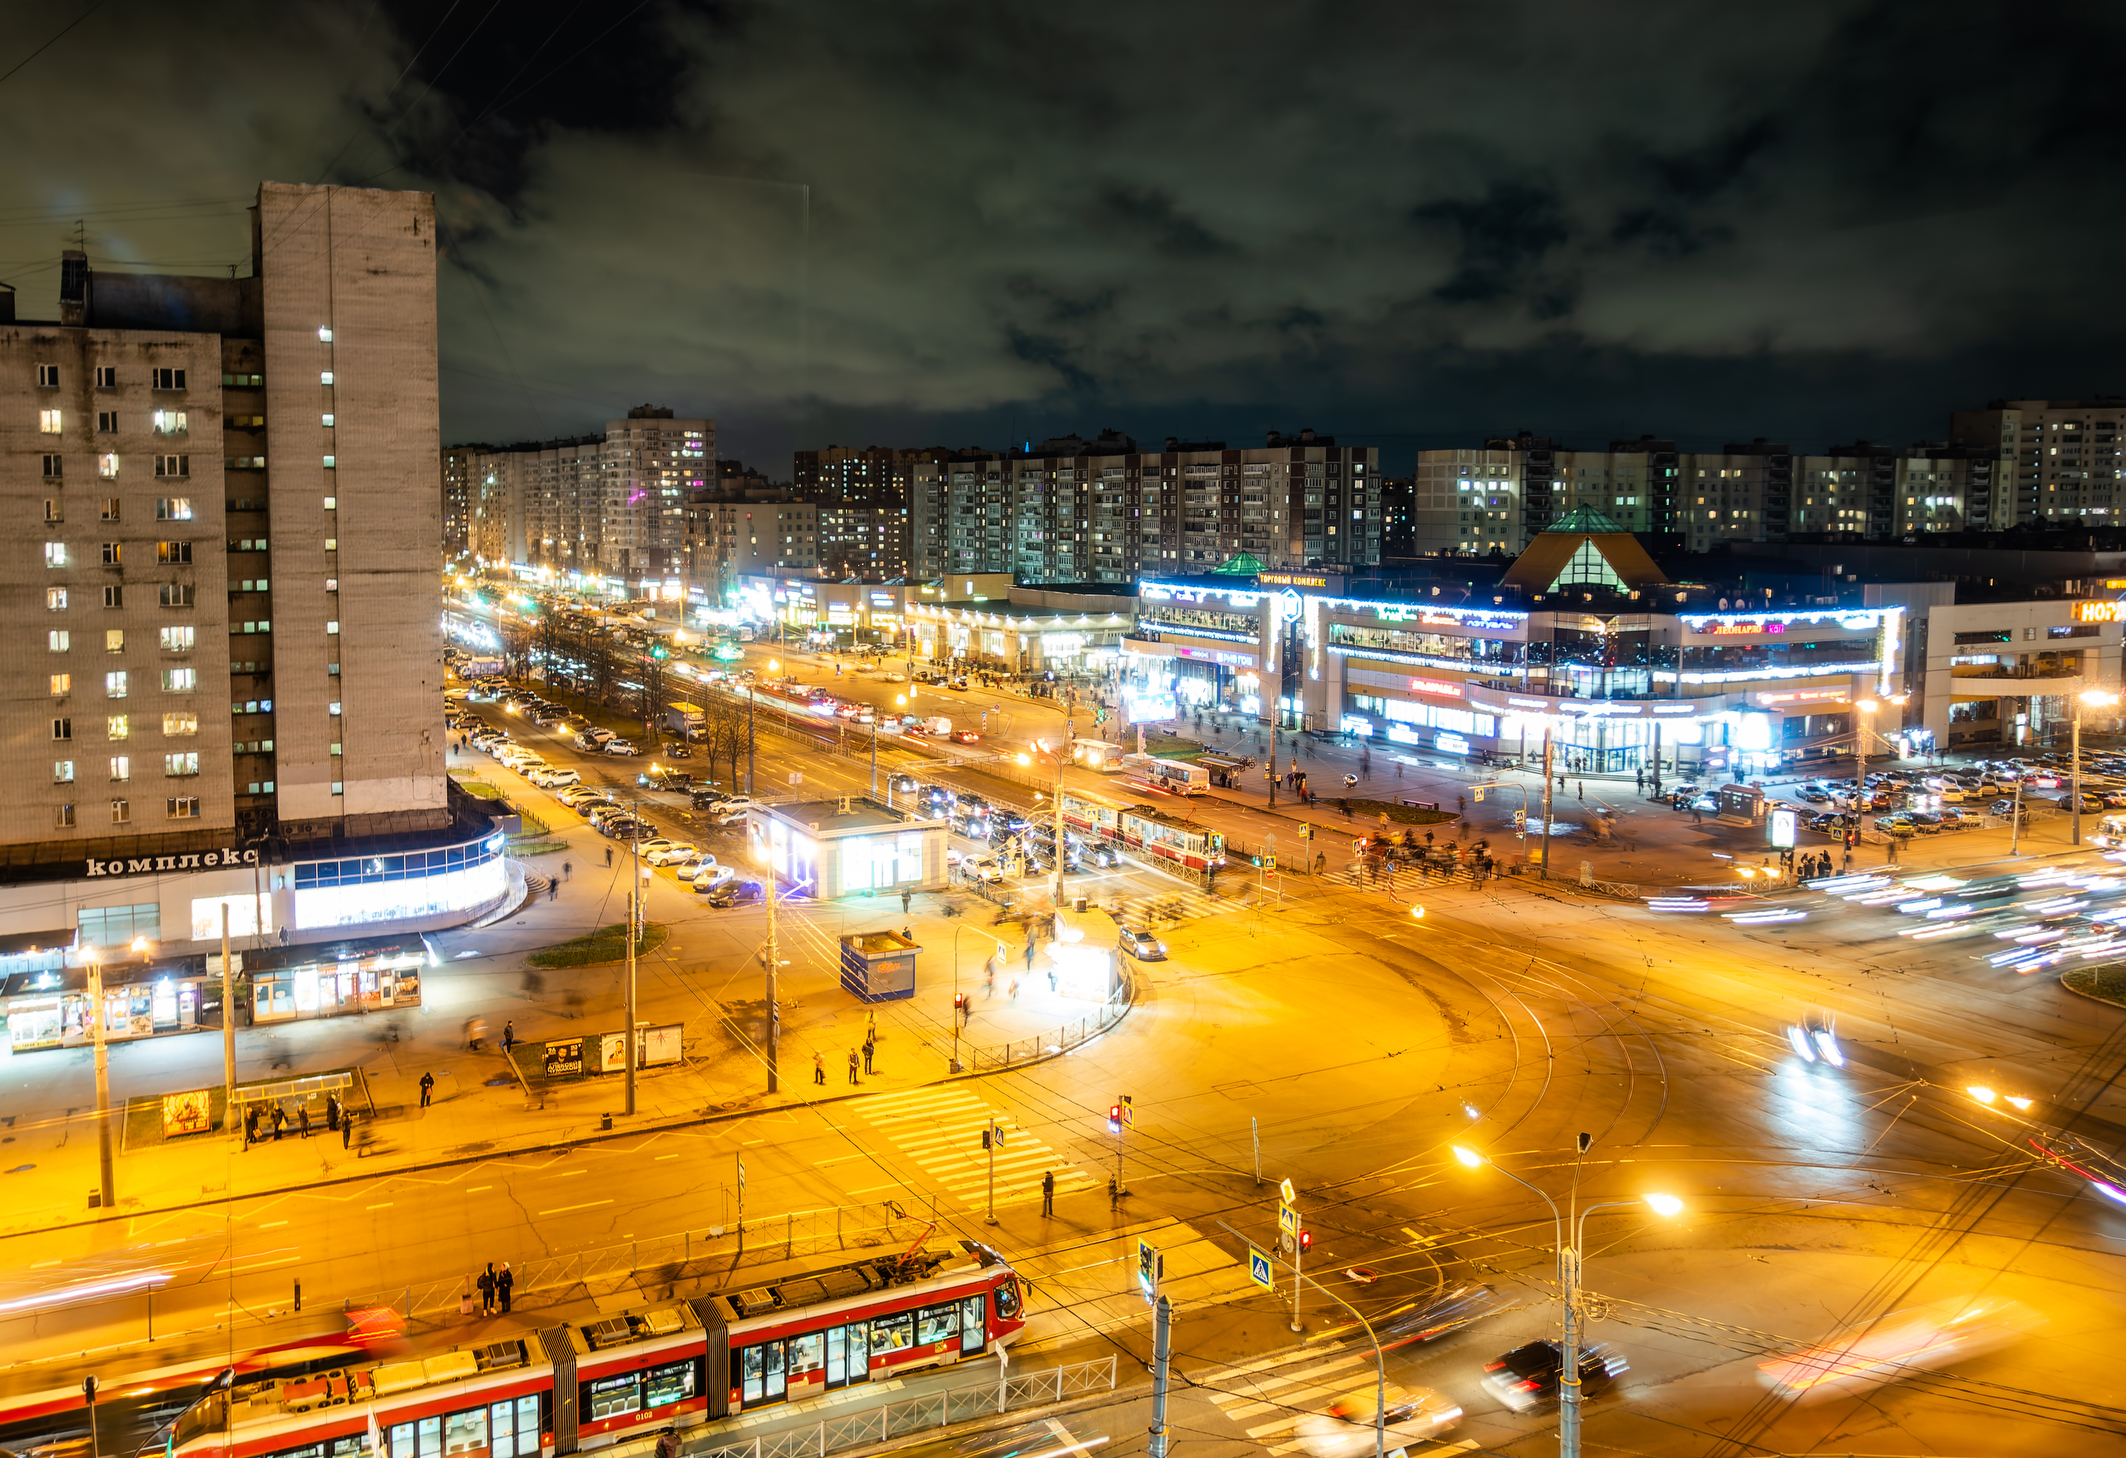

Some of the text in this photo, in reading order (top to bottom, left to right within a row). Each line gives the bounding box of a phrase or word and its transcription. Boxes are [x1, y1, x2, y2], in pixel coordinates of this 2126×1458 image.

[1260, 574, 1326, 587] ТОРГОВЫЙ КОМПЛЕКС
[1713, 625, 1763, 635] ЛЕОНАРДО
[86, 847, 256, 877] комплекс
[635, 1411, 653, 1421] 0102
